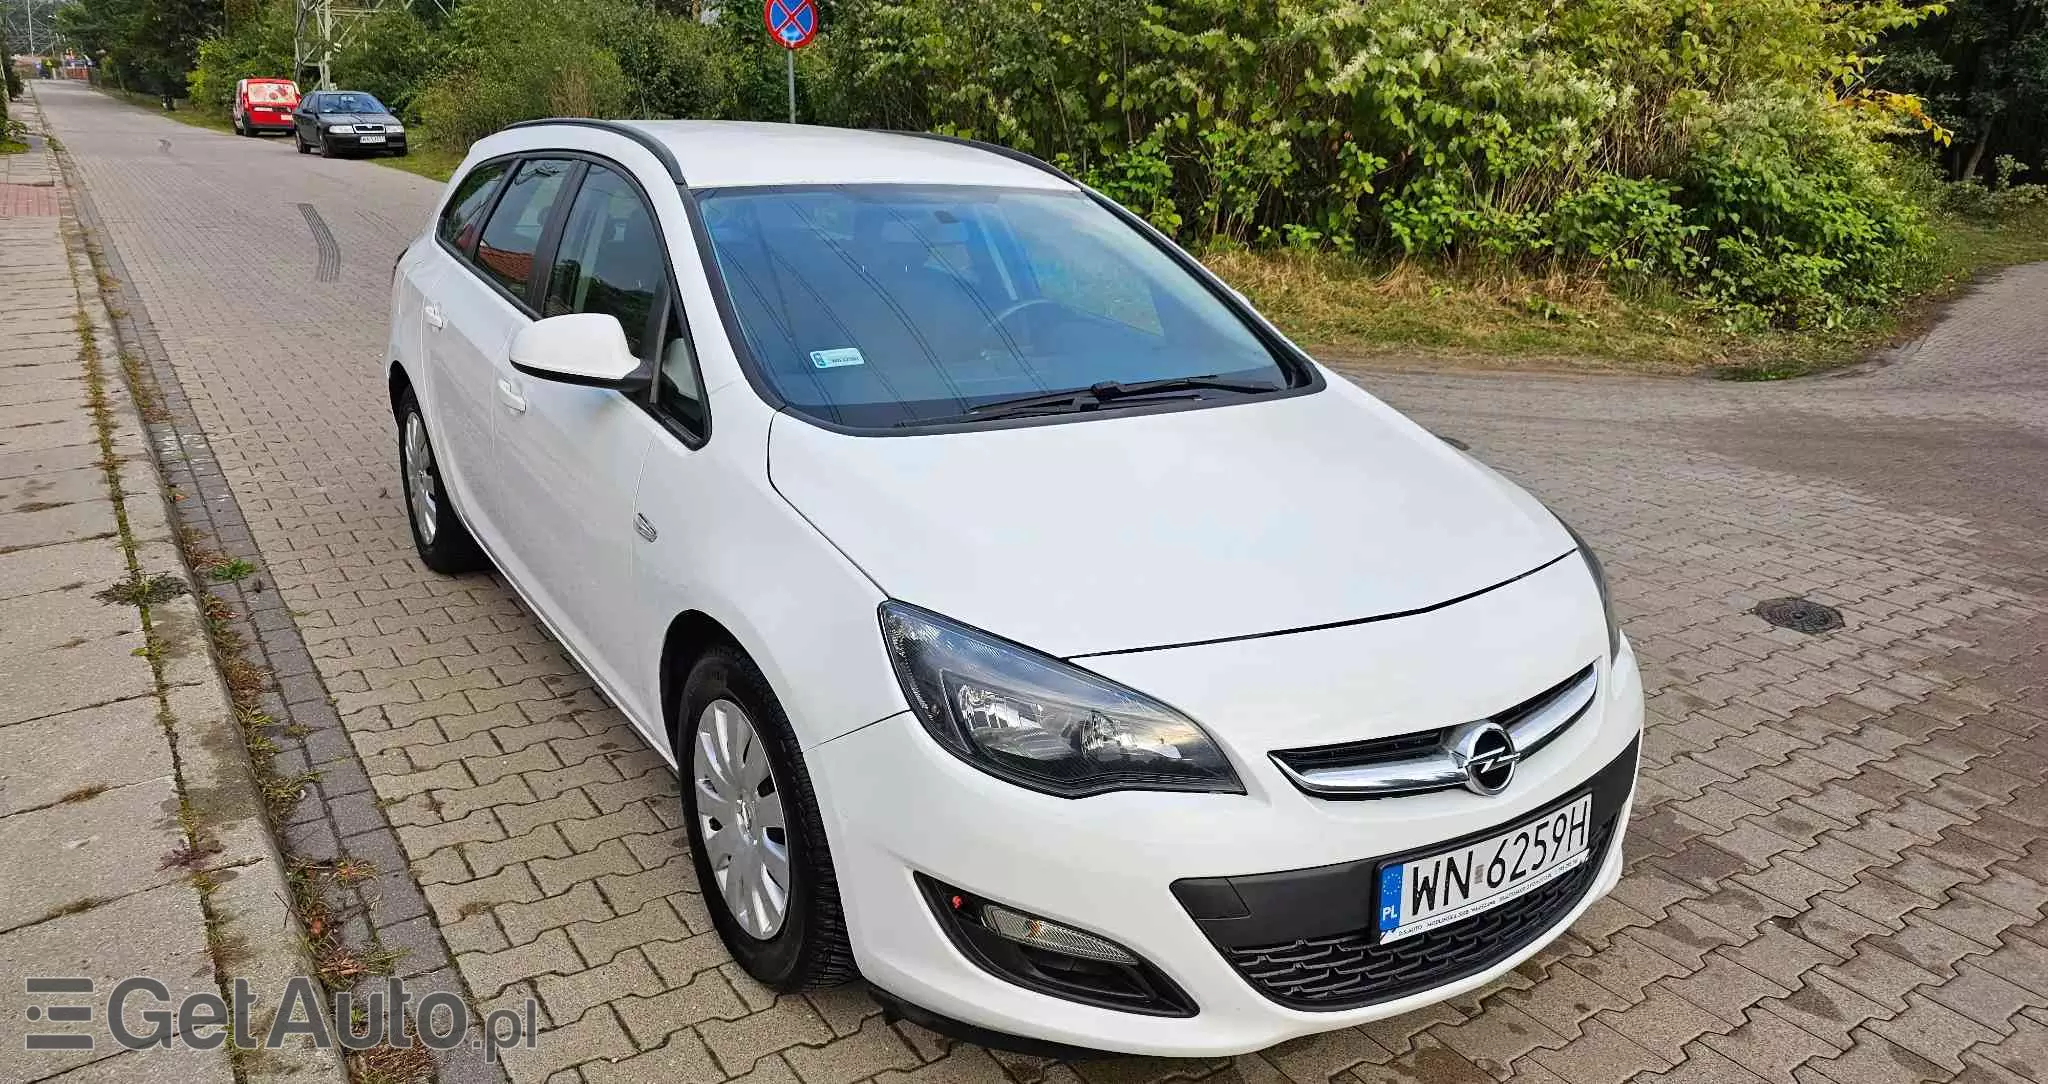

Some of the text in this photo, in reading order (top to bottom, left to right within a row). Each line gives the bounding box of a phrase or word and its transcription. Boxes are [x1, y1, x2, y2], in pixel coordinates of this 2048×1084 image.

[1412, 850, 1473, 916] WN
[1486, 800, 1588, 890] 6259H
[1382, 905, 1398, 921] PL
